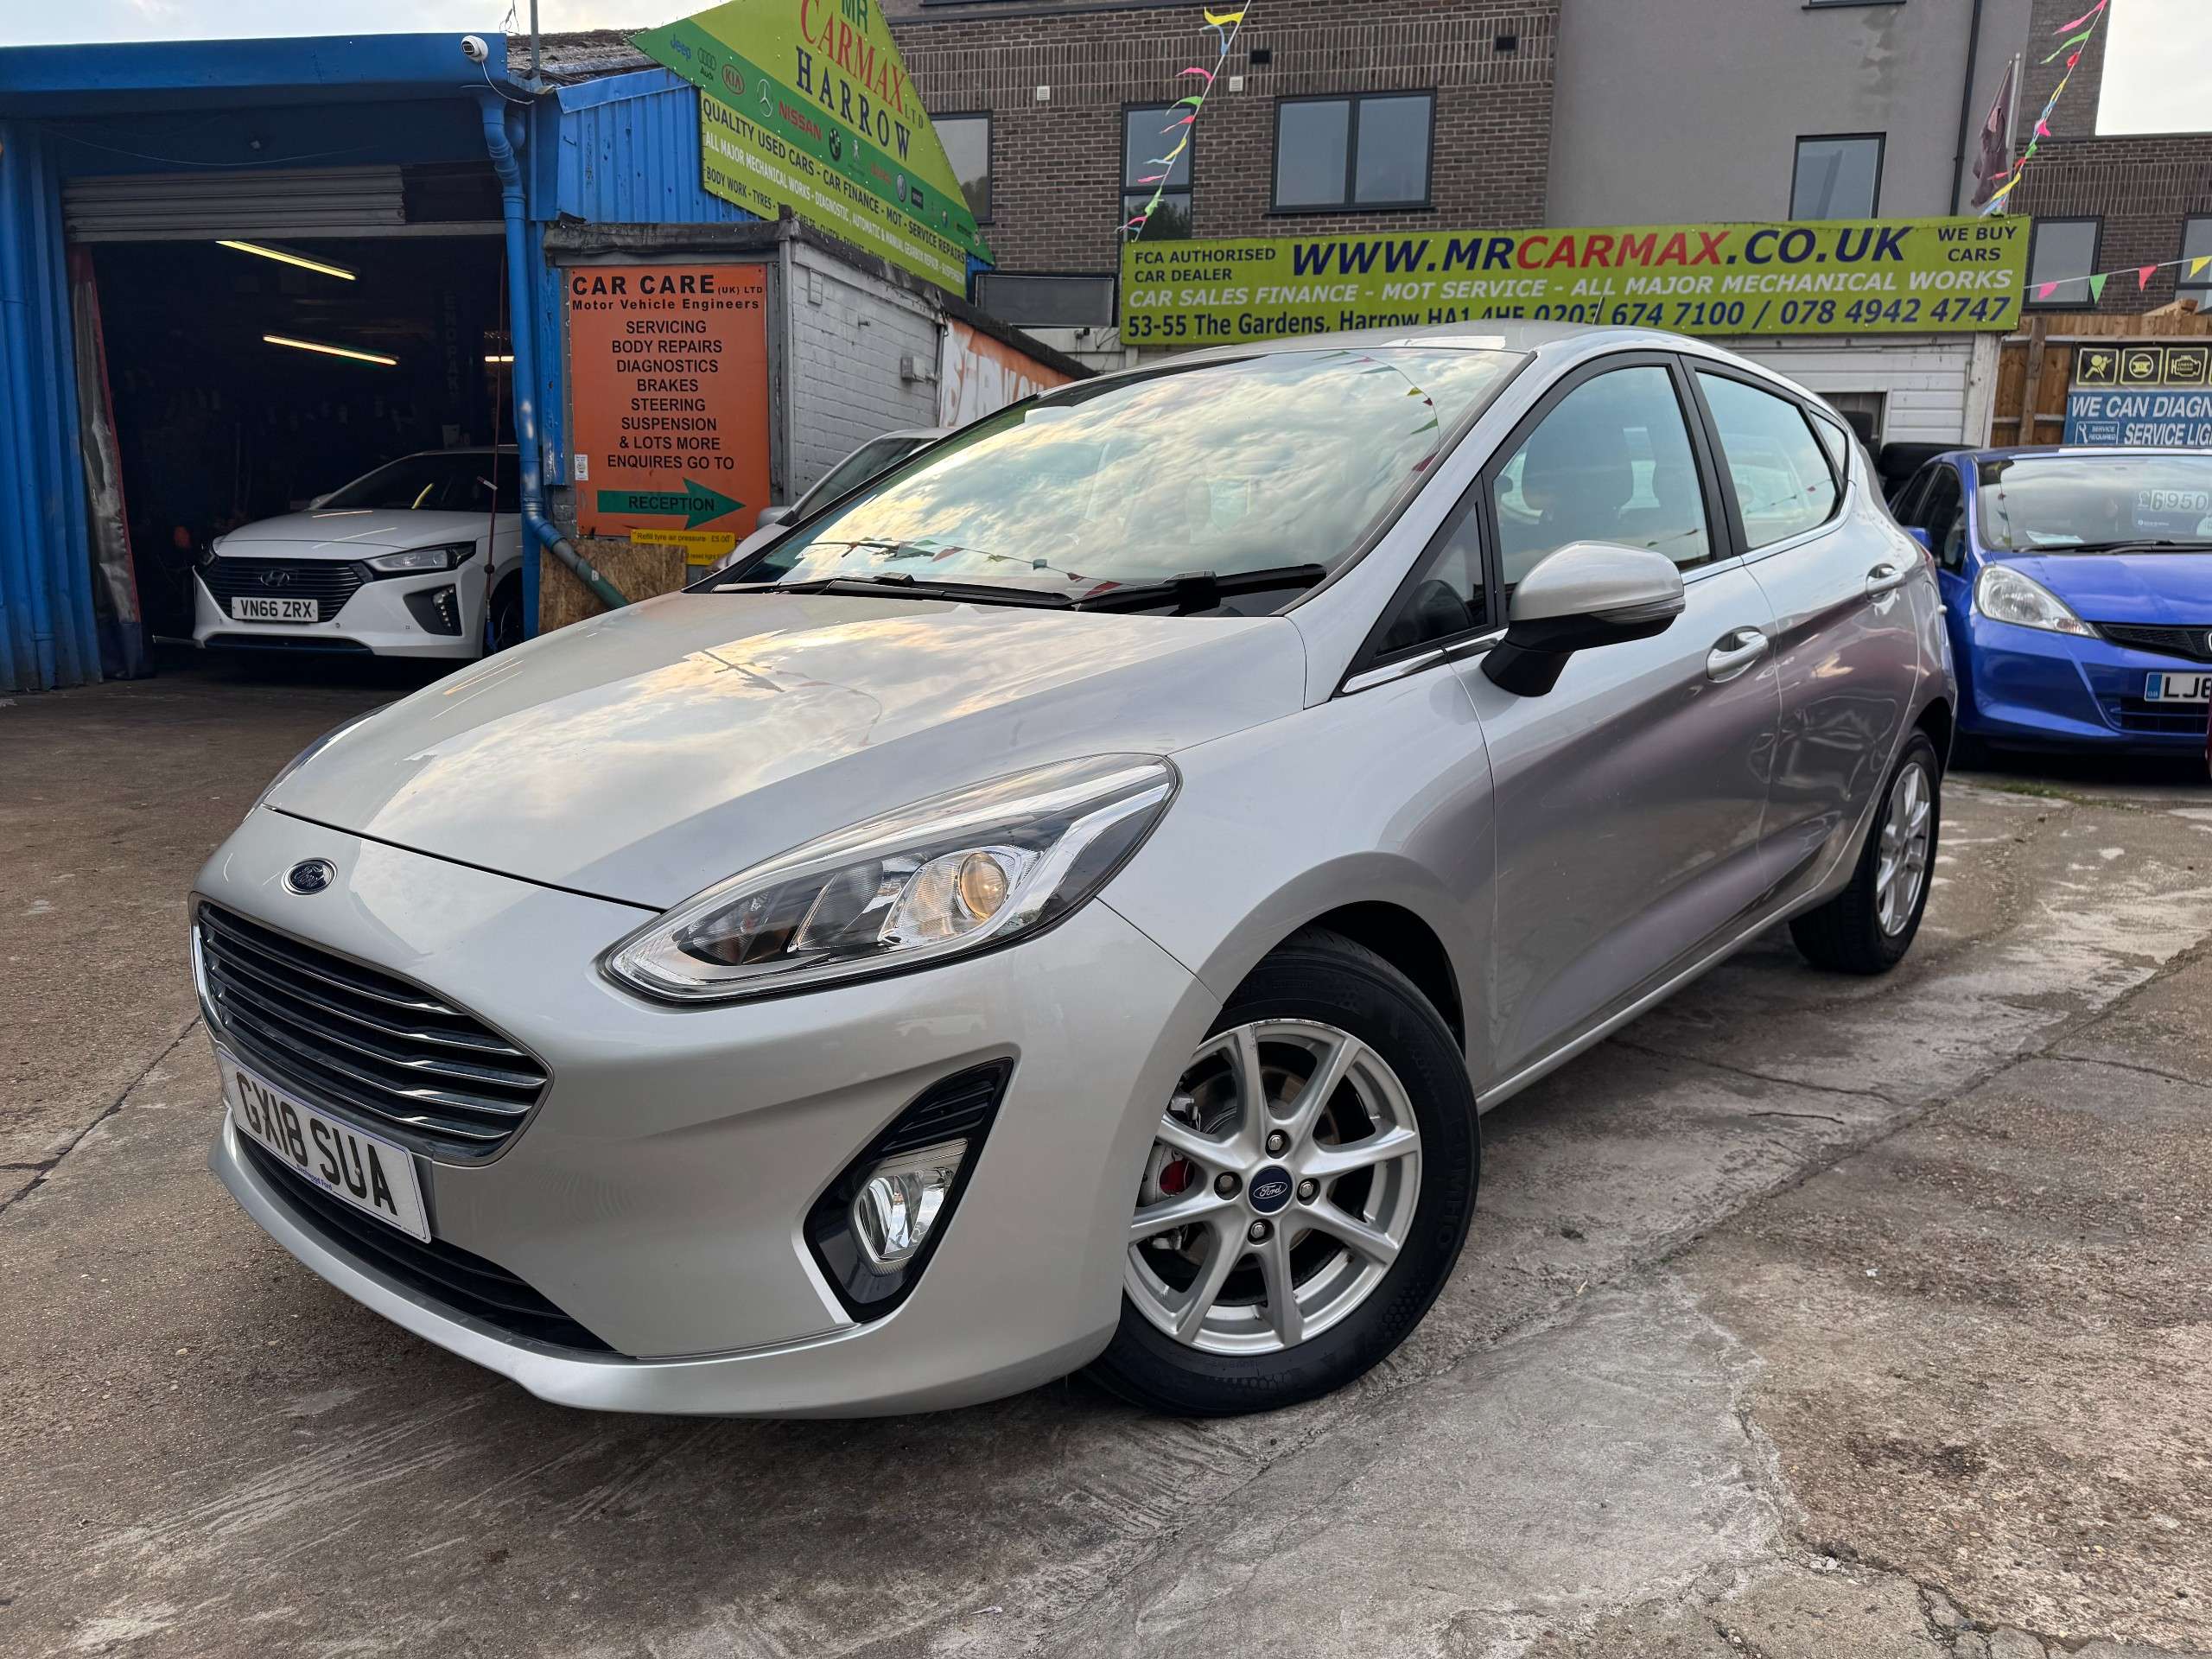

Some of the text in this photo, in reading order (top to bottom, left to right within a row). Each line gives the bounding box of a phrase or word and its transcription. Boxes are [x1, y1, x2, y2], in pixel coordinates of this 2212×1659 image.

[842, 0, 868, 34] MR
[671, 35, 691, 61] Jeep
[800, 0, 924, 129] CARMAX LTD
[724, 67, 742, 90] KIA
[796, 45, 911, 162] HARROW
[779, 100, 822, 141] NISSAN
[705, 131, 720, 153] ALL
[721, 138, 745, 167] MAJOR
[746, 152, 788, 189] MECHANICAL
[788, 177, 810, 201] WORKS
[703, 98, 754, 142] QUALITY
[758, 130, 786, 159] USED
[789, 149, 814, 176] CARS
[823, 169, 842, 193] CAR
[843, 181, 879, 215] FINANCE
[887, 207, 902, 228] MOT
[908, 220, 937, 249] SERVICE
[938, 240, 965, 264] REPAIRS
[707, 166, 725, 188] BODY
[727, 175, 747, 199] WORK
[753, 188, 772, 210] TYRES
[1938, 226, 2018, 243] WE BUY
[1135, 248, 1276, 264] FCA AUTHORISED
[1294, 226, 1915, 276] WWW.MRCARMAX.CO.UK
[1948, 247, 2001, 263] CARS
[572, 276, 627, 296] CAR
[640, 275, 715, 295] CARE
[717, 286, 741, 296] (UK)
[1135, 268, 1232, 283] CAR DEALER
[1129, 289, 1173, 308] CAR
[1179, 287, 1249, 307] SALES
[1255, 284, 1359, 306] FINANCE
[1382, 282, 1436, 301] MOT
[1440, 278, 1548, 299] SERVICE
[1571, 277, 1616, 296] ALL
[1624, 276, 1713, 296] MAJOR
[1720, 271, 1897, 294] MECHANICAL
[1909, 269, 2013, 290] WORKS
[572, 298, 760, 312] Motor Vehicle Engineers
[1128, 315, 1186, 337] 53-55
[1194, 313, 1231, 335] The
[1238, 311, 1331, 335] Gardens,
[1340, 310, 1420, 332] Harrow
[1428, 306, 1469, 325] HA1
[1611, 302, 1663, 326] 674
[1675, 300, 1746, 326] 7100
[1781, 299, 1836, 326] 078
[1845, 297, 1922, 323] 4942
[1930, 296, 2012, 322] 4747
[626, 320, 707, 334] SERVICING
[612, 340, 722, 353] BODY REPAIRS
[617, 359, 718, 373] DIAGNOSTICS
[637, 378, 699, 392] BRAKES
[631, 397, 706, 412] STEERING
[2072, 396, 2212, 418] WE CAN DIAGN
[621, 417, 717, 431] SUSPENSION
[620, 436, 721, 450] & LOTS MORE
[2124, 423, 2212, 446] SERVICE LIG
[607, 454, 734, 470] ENQUIRES GO TO
[629, 495, 715, 512] RECEPTION
[654, 533, 666, 542] tyre
[677, 535, 706, 543] pressure
[241, 599, 312, 619] VN66 ZRX
[236, 1071, 397, 1216] GX18 SUA
[1259, 1184, 1282, 1198] Ford
